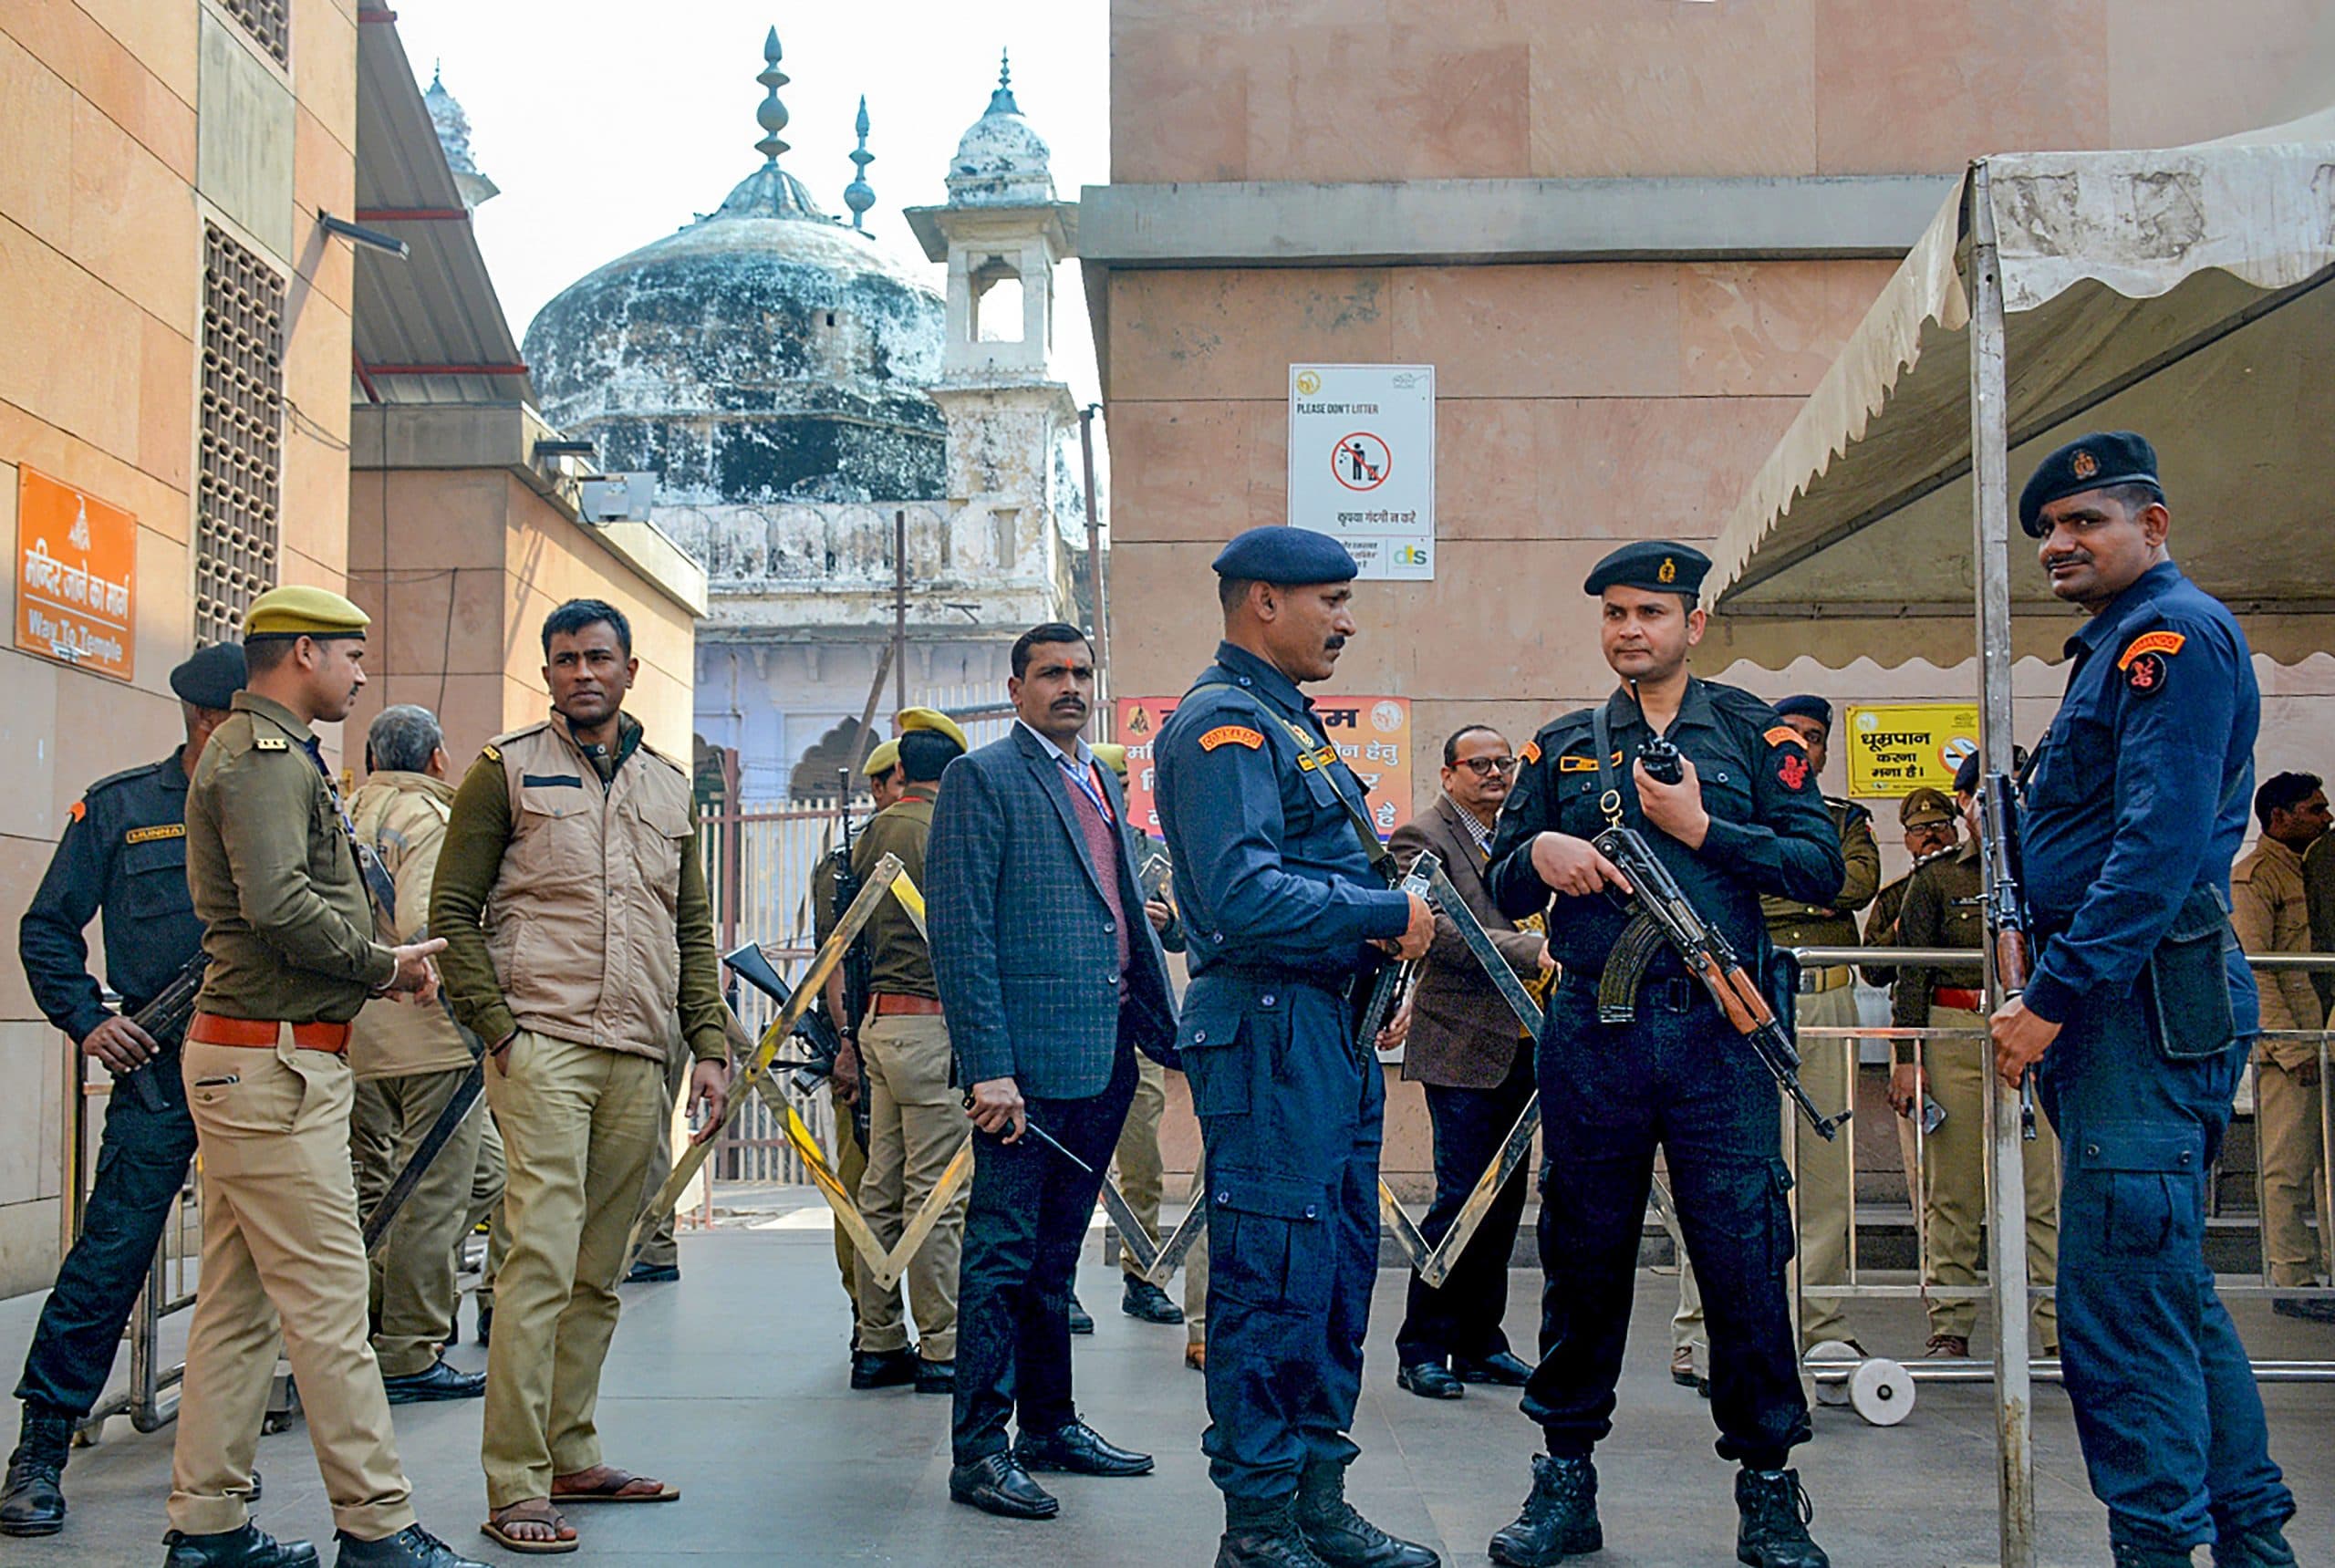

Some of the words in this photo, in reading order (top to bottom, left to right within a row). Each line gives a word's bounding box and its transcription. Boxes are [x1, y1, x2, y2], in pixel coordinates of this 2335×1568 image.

[1297, 403, 1326, 414] PLEASE
[1327, 403, 1350, 414] DON'T
[1352, 403, 1379, 414] LITTER
[62, 558, 88, 606] जाने
[89, 575, 105, 612] का
[28, 608, 58, 642] Way
[60, 619, 77, 649] To
[79, 625, 123, 664] Temple
[1365, 740, 1399, 766] हेतु
[1860, 732, 1931, 753] धूम्रपान
[1876, 753, 1917, 763] करना
[1375, 801, 1397, 827] है
